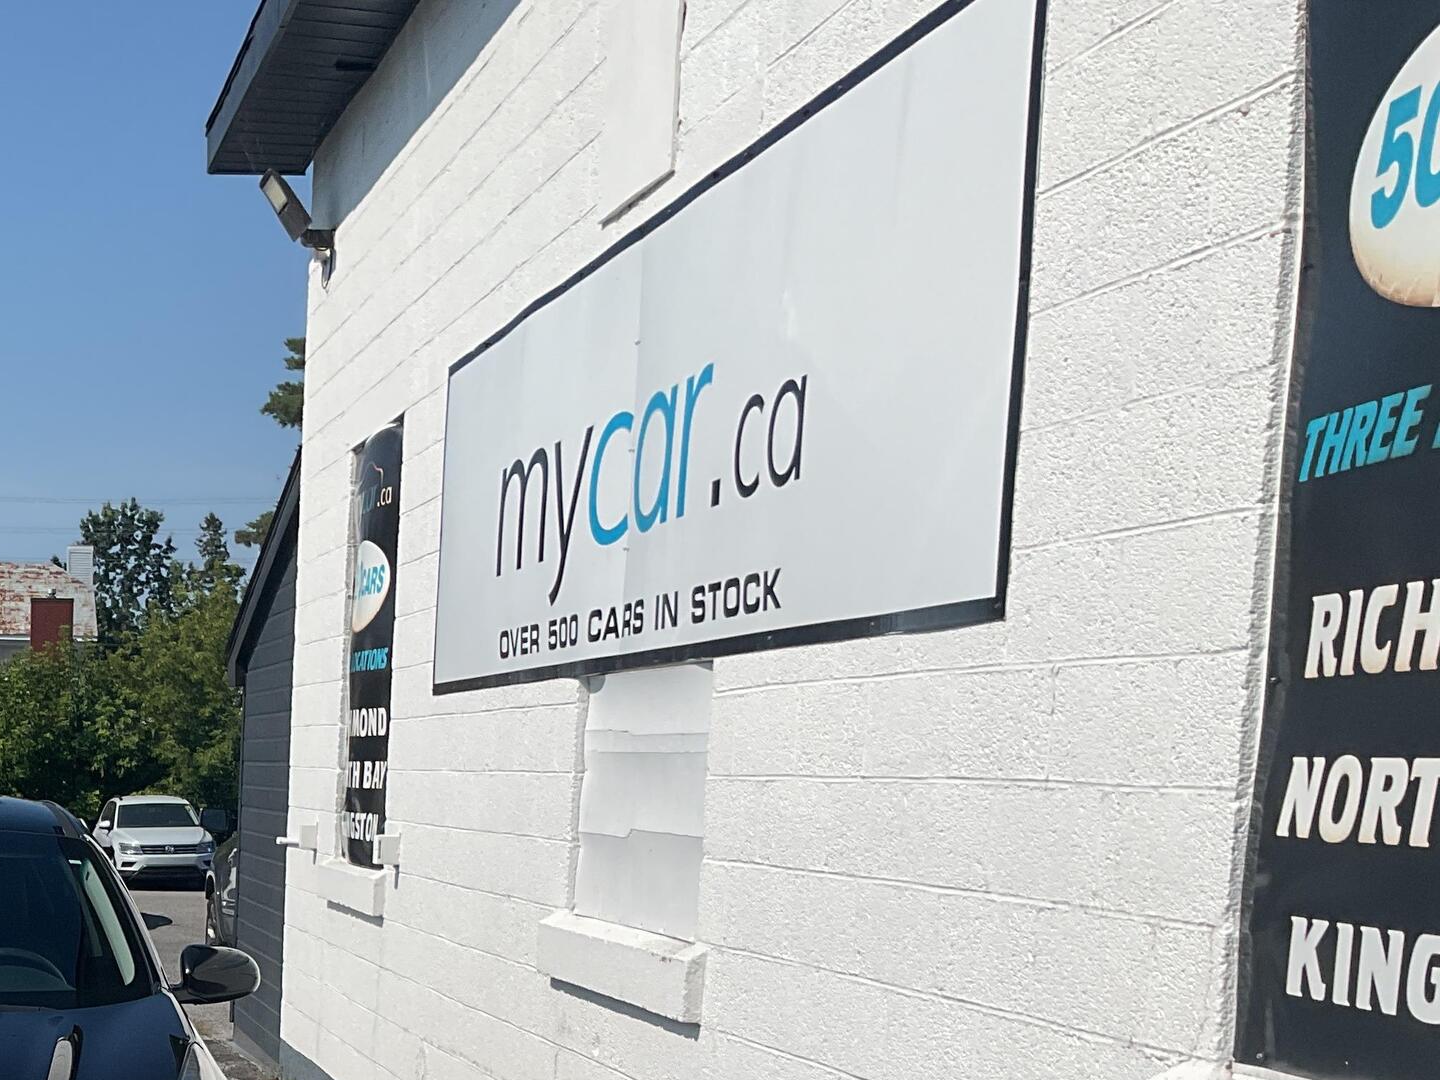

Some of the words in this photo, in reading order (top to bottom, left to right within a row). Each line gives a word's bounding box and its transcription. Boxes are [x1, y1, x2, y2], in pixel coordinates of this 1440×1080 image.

[1298, 384, 1433, 483] THREE
[496, 363, 808, 605] mycar.ca
[499, 623, 540, 659] OVER
[548, 614, 579, 650] 500
[588, 599, 644, 643] CARS
[654, 591, 679, 631] IN
[691, 568, 782, 624] STOCK
[1304, 578, 1440, 679] RICH
[363, 761, 388, 789] BAY
[1276, 754, 1440, 848] NORT
[349, 811, 379, 842] GSTON
[1285, 915, 1440, 1025] KING
